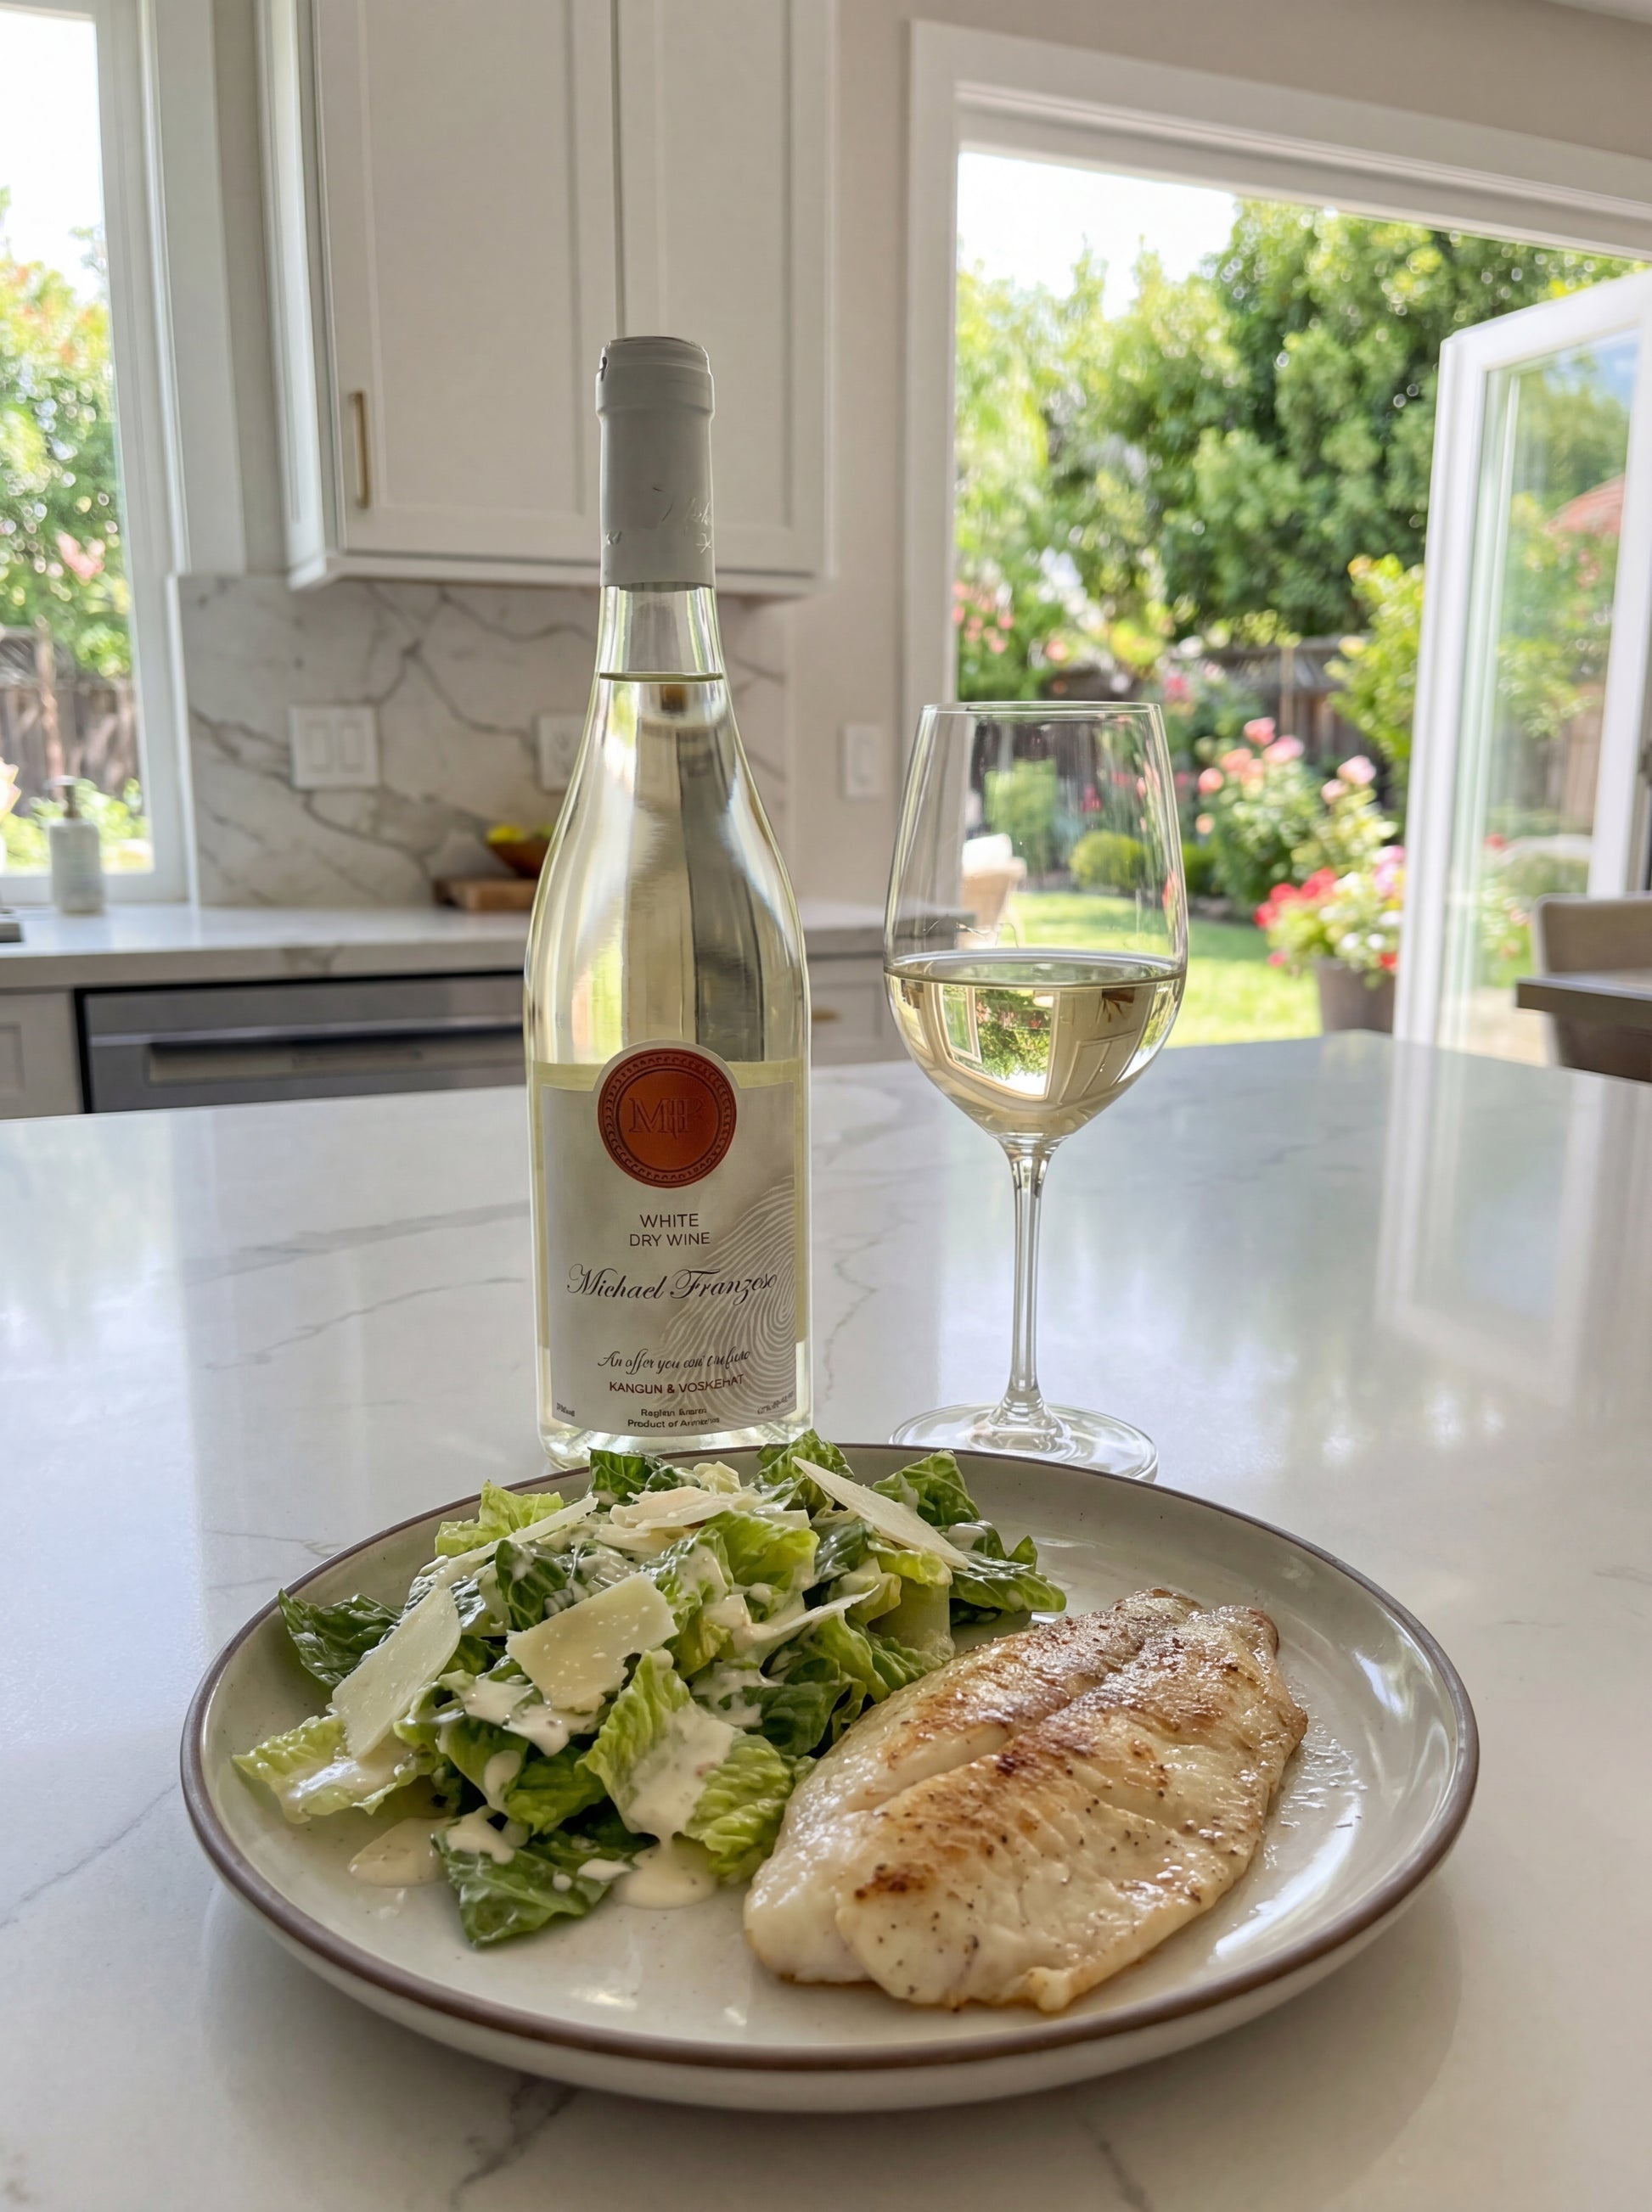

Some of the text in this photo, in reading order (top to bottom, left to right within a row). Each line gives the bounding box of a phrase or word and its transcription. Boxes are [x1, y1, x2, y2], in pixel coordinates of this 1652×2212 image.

[640, 1213, 700, 1228] WHITE
[629, 1232, 711, 1247] DRY WINE
[567, 1263, 668, 1299] Michael
[597, 1351, 622, 1367] An
[625, 1348, 655, 1374] offer
[656, 1358, 679, 1374] you
[610, 1373, 744, 1394] KANGUN & VOSKEHAT
[627, 1418, 666, 1428] Product
